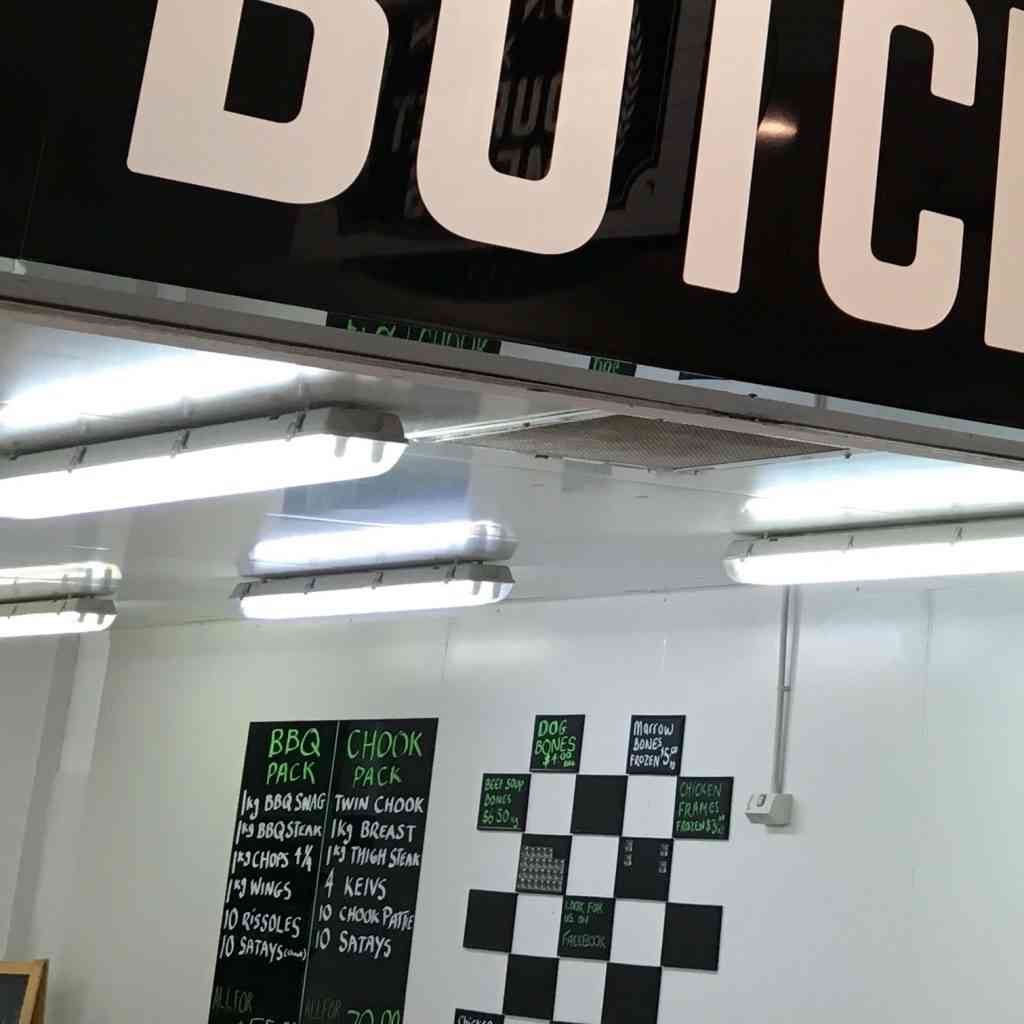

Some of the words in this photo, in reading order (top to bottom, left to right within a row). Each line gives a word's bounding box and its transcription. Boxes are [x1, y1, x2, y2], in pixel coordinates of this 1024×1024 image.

[538, 719, 568, 738] DOG
[268, 728, 321, 758] BBQ
[347, 729, 423, 760] CHOOK
[534, 736, 577, 756] BONES
[633, 737, 662, 751] BONES
[629, 753, 660, 768] FROZEN
[266, 761, 316, 785] PACK
[352, 766, 403, 787] PACK
[264, 793, 293, 812] BBQ
[334, 794, 370, 812] TWIN
[374, 795, 425, 814] CHOOK
[256, 821, 285, 842] BBQ
[285, 821, 322, 838] STEAK
[360, 820, 417, 842] BREAST
[252, 851, 289, 869] CHOPS
[350, 846, 387, 866] THIGH
[388, 847, 421, 868] STEAK
[249, 877, 292, 900] WINGS
[223, 907, 239, 930] 10
[318, 903, 332, 922] 10
[338, 906, 380, 924] CHOOK
[219, 934, 235, 959] 10
[238, 936, 283, 963] SATAYS
[315, 927, 331, 950] 10
[338, 930, 392, 960] SATAYS
